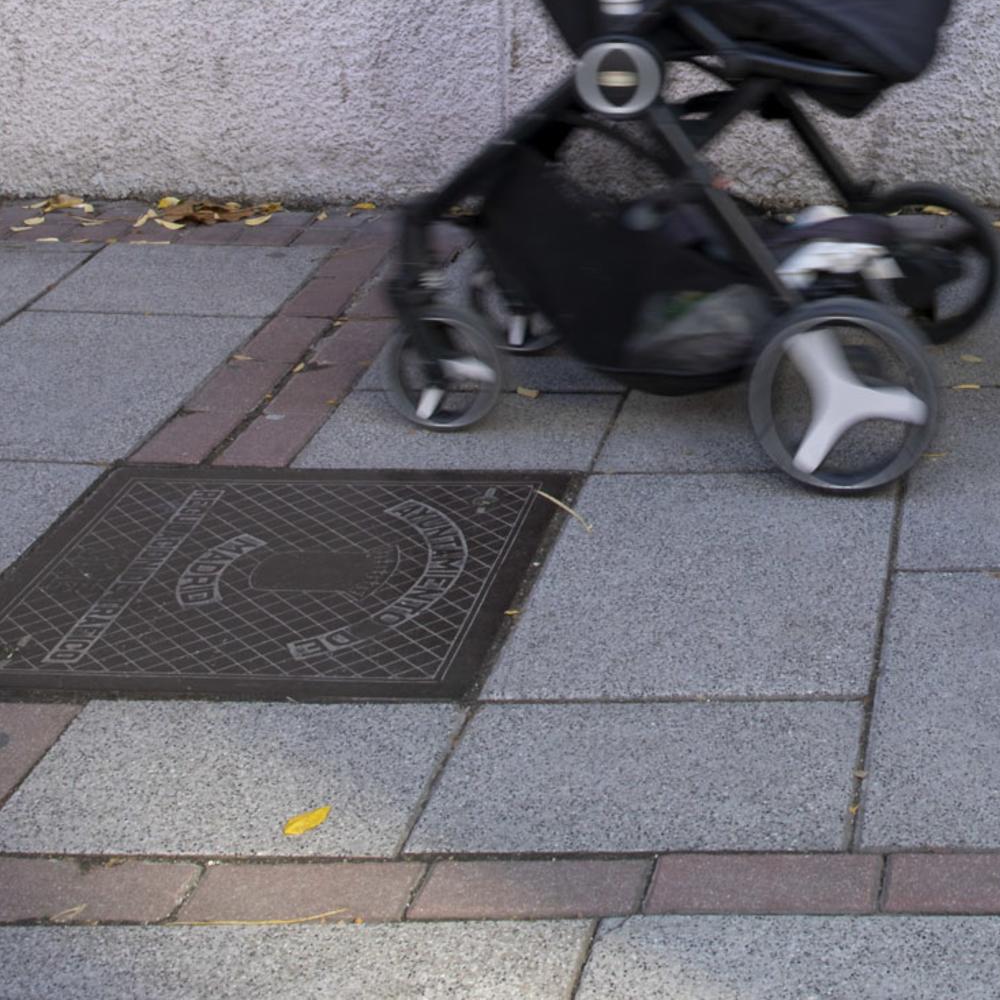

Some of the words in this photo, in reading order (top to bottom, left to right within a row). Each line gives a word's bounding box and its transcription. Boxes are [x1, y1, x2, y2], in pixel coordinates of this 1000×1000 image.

[179, 535, 264, 604] MADRID
[373, 501, 465, 626] AYUNTAMIENTO
[292, 630, 351, 656] DE
